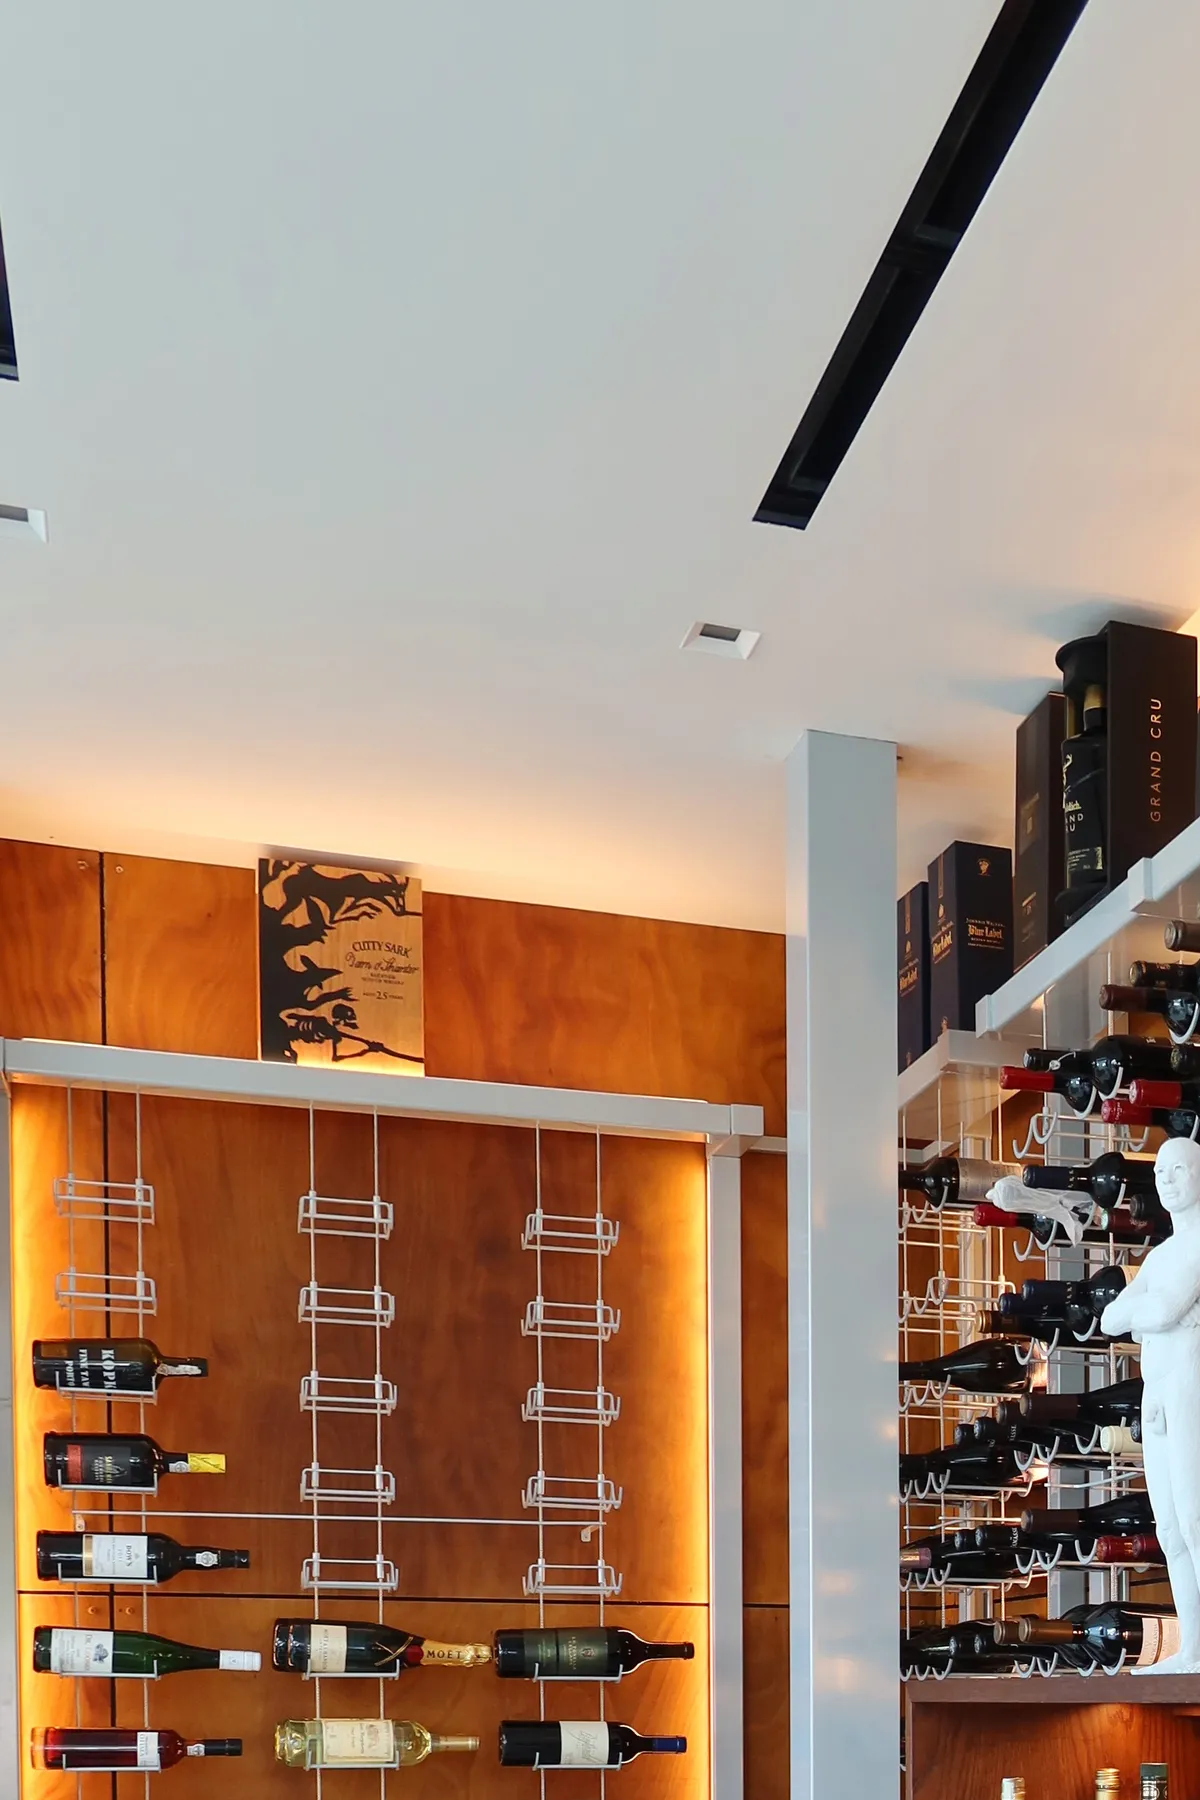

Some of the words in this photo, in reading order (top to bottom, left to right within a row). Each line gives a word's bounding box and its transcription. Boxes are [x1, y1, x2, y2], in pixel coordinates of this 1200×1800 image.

[1150, 697, 1162, 739] CRU
[1150, 750, 1162, 822] GRAND
[967, 923, 984, 937] Blue
[985, 925, 1004, 939] Label
[352, 940, 384, 952] CUTTY
[384, 942, 413, 958] SARK
[376, 990, 388, 1001] 25
[79, 1348, 88, 1369] FINE
